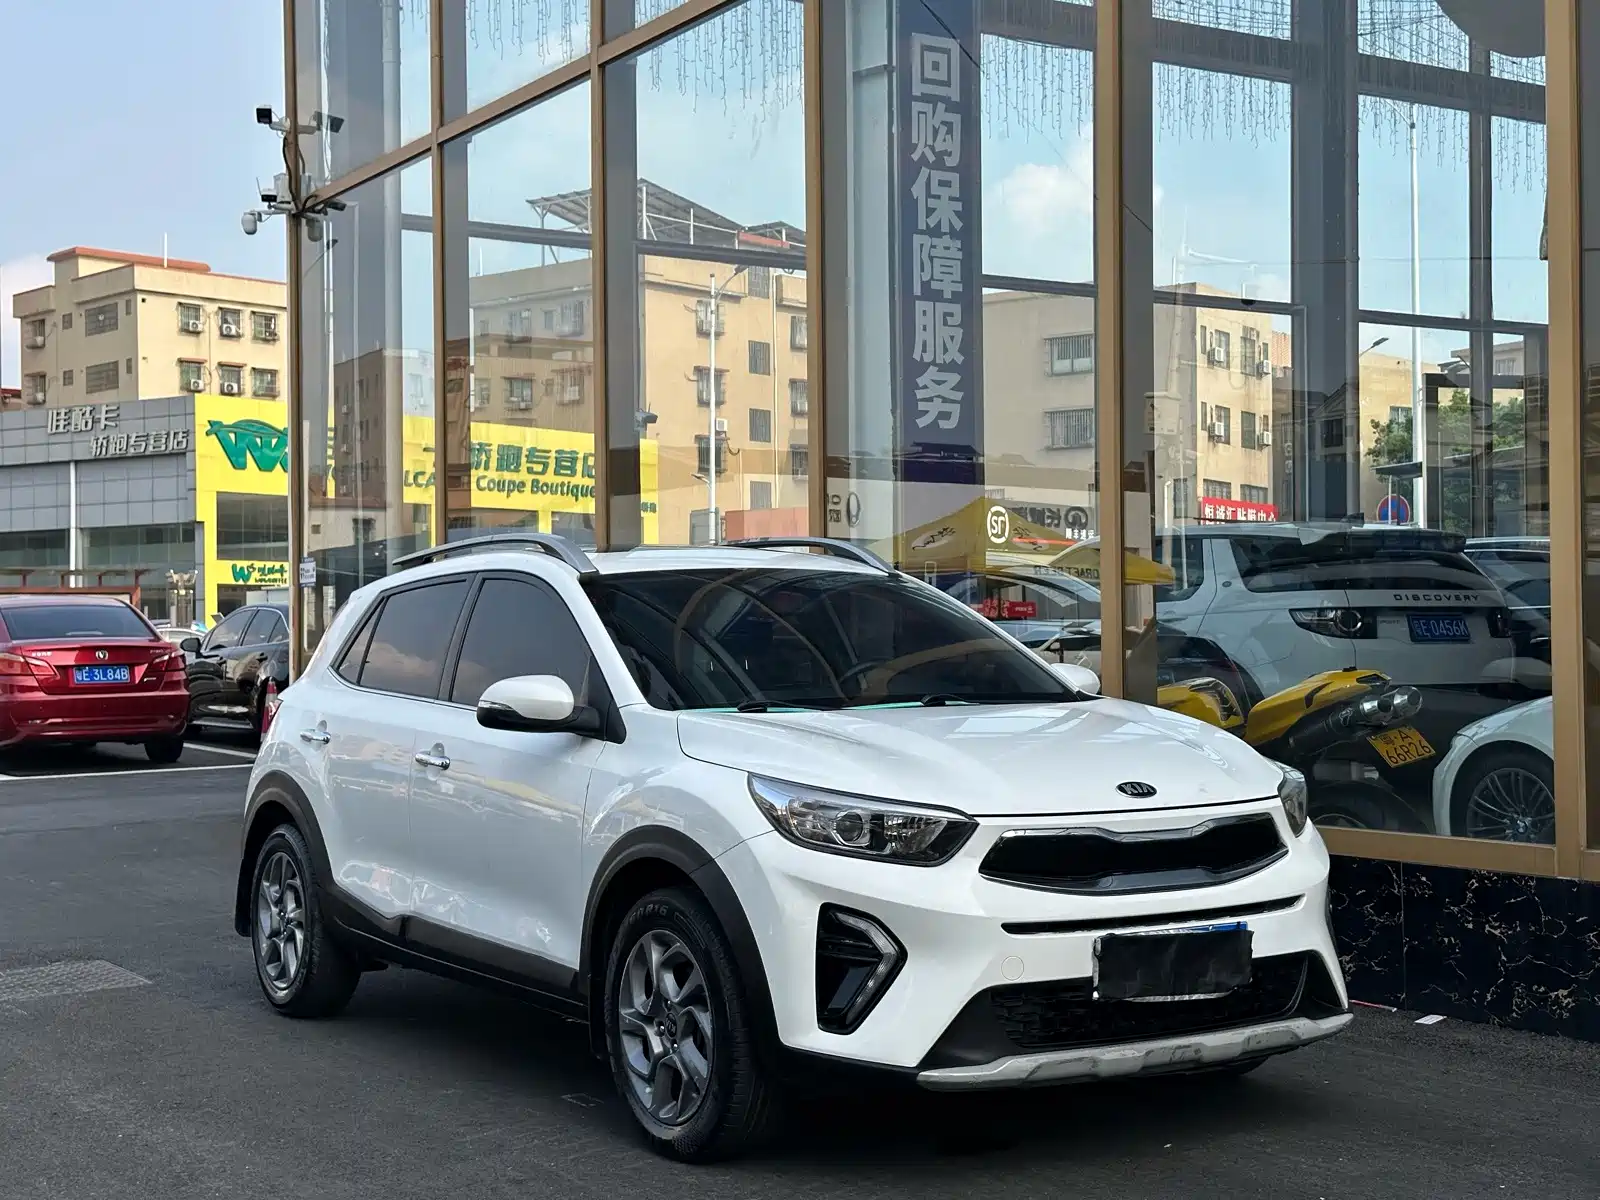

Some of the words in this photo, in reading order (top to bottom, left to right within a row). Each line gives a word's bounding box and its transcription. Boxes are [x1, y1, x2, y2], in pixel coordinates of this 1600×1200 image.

[910, 32, 964, 430] 回购保障服务
[47, 403, 121, 434] 哇酷卡
[89, 428, 190, 457] 轿跑专营店
[476, 474, 525, 498] Coupe
[531, 478, 595, 502] Boutique
[1393, 593, 1480, 602] DISCOVERY
[1385, 739, 1432, 764] 66R26
[1120, 783, 1154, 795] KIA
